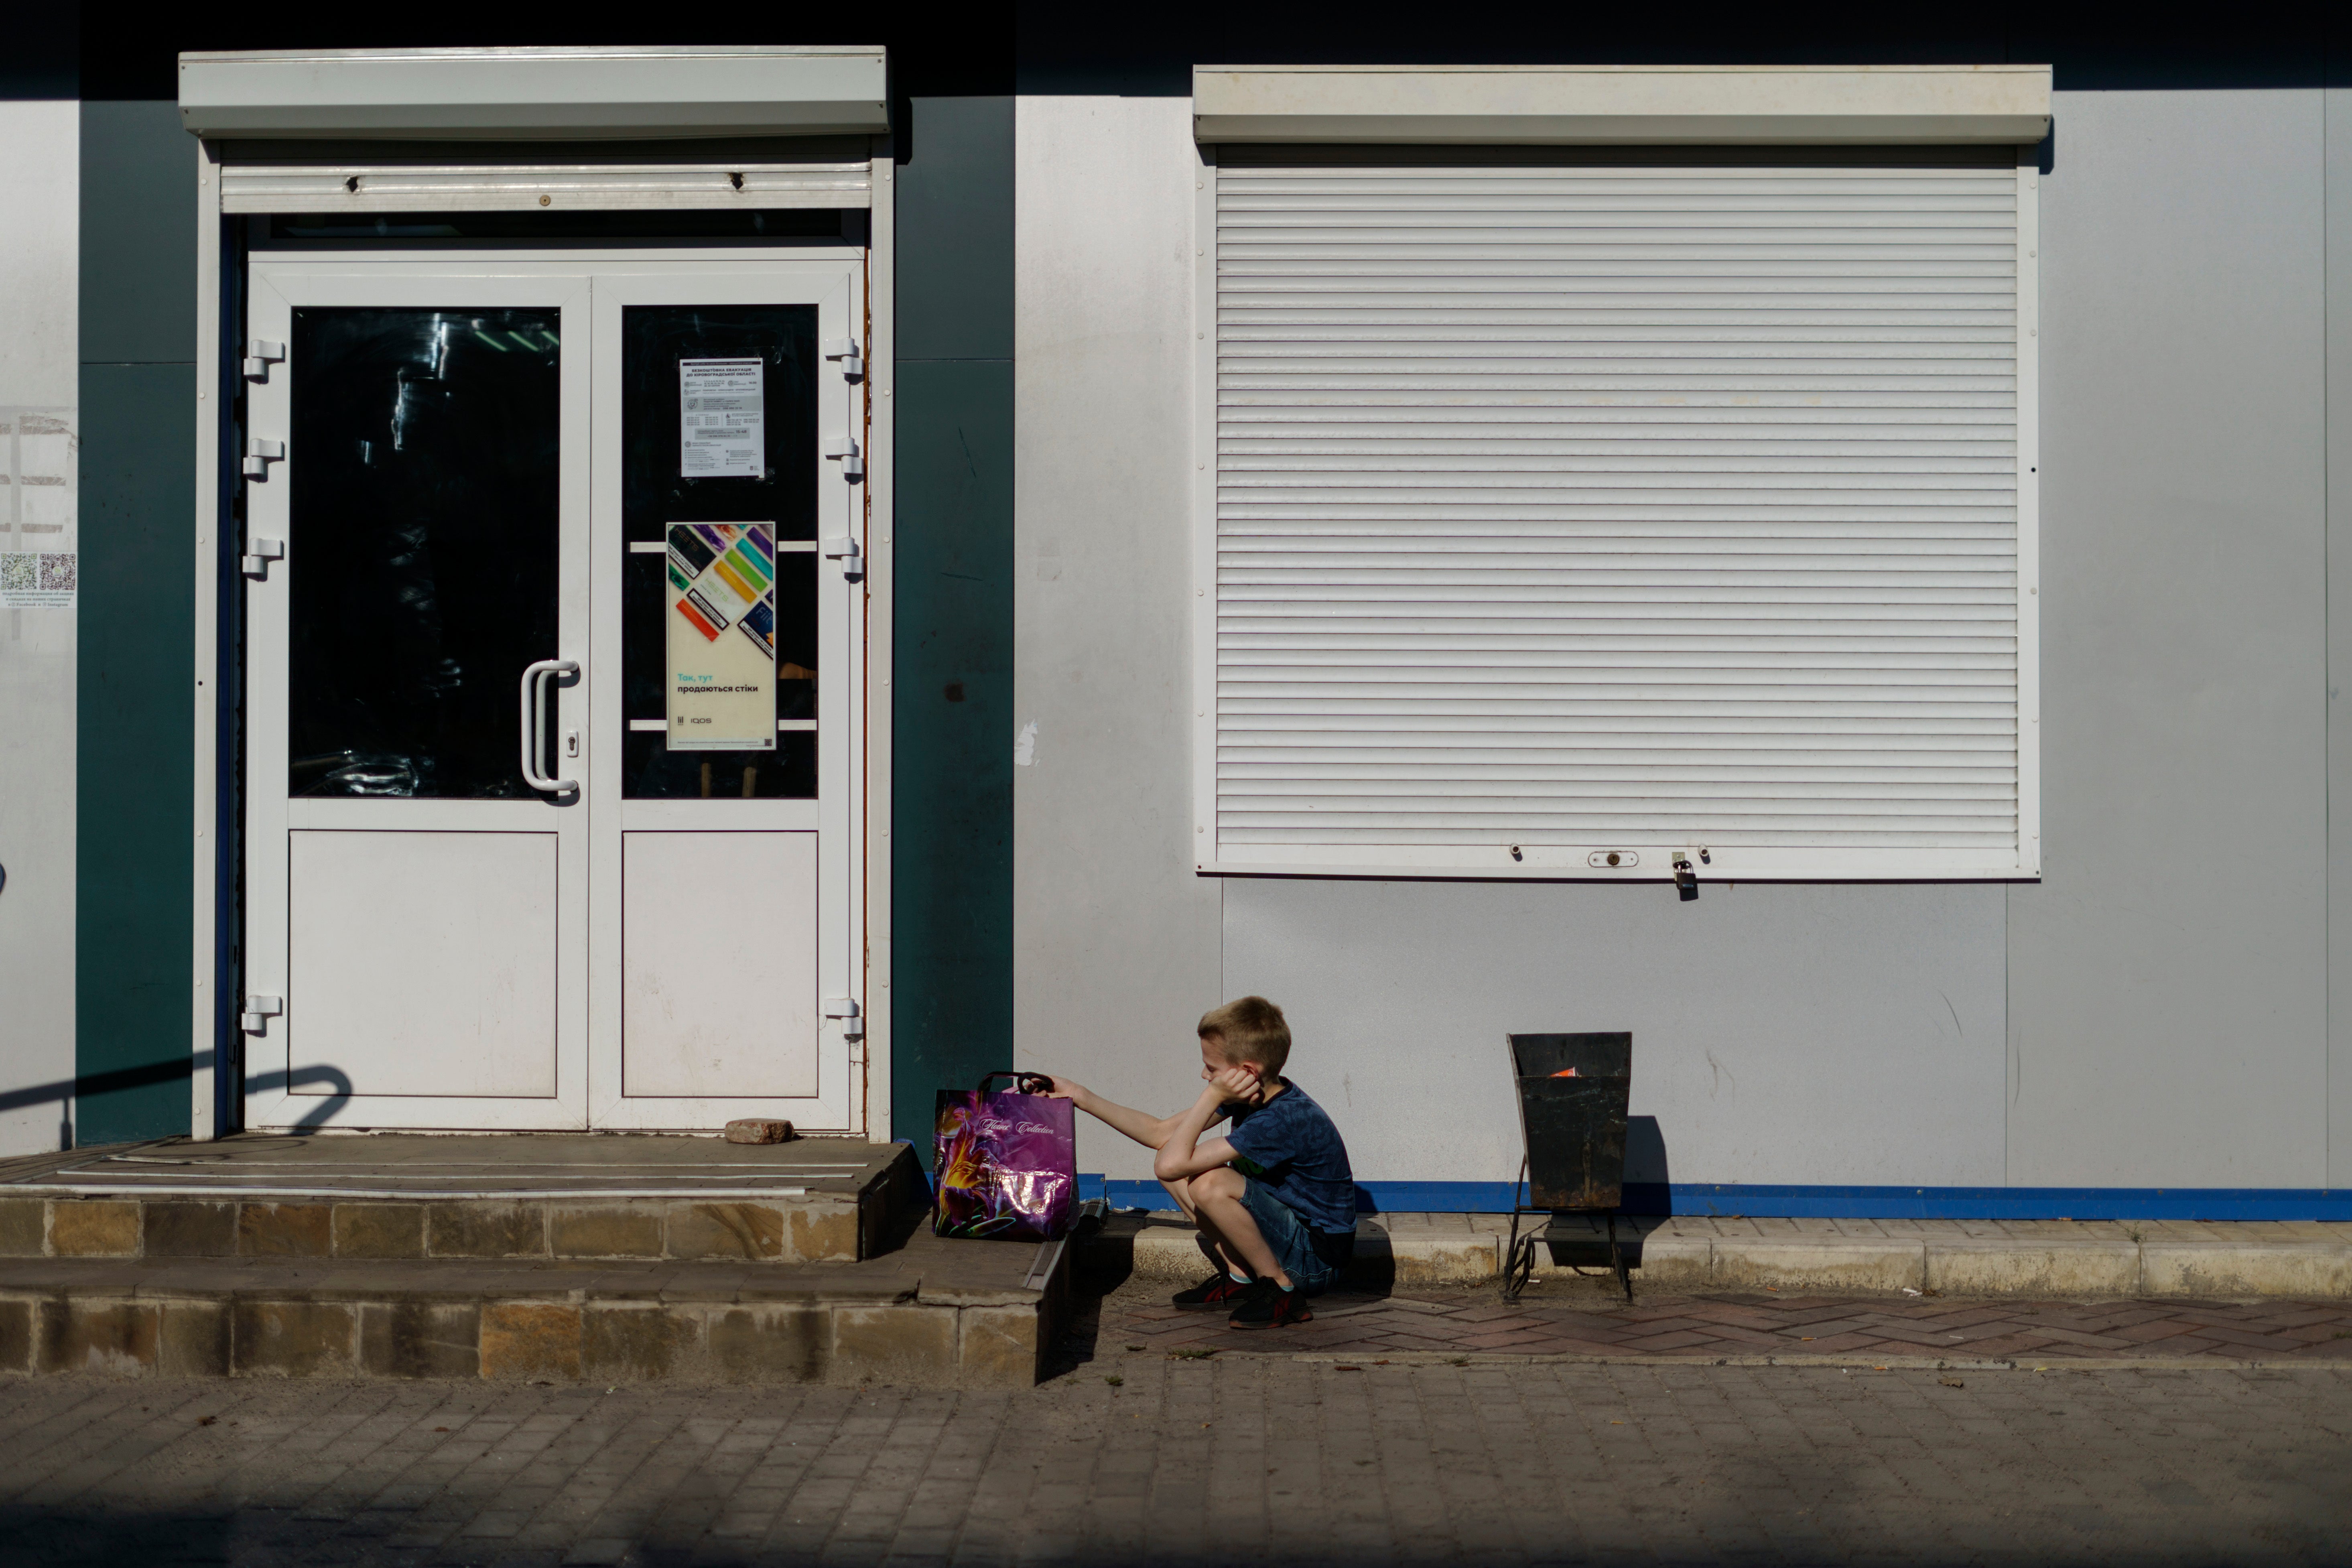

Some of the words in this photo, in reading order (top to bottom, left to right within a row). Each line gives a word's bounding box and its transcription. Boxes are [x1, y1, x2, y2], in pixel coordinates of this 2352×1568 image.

[674, 527, 699, 551] HEETS
[705, 578, 729, 602] HEETS
[678, 674, 696, 682] Так,
[979, 1119, 1010, 1130] Flower
[1016, 1121, 1054, 1135] Collection
